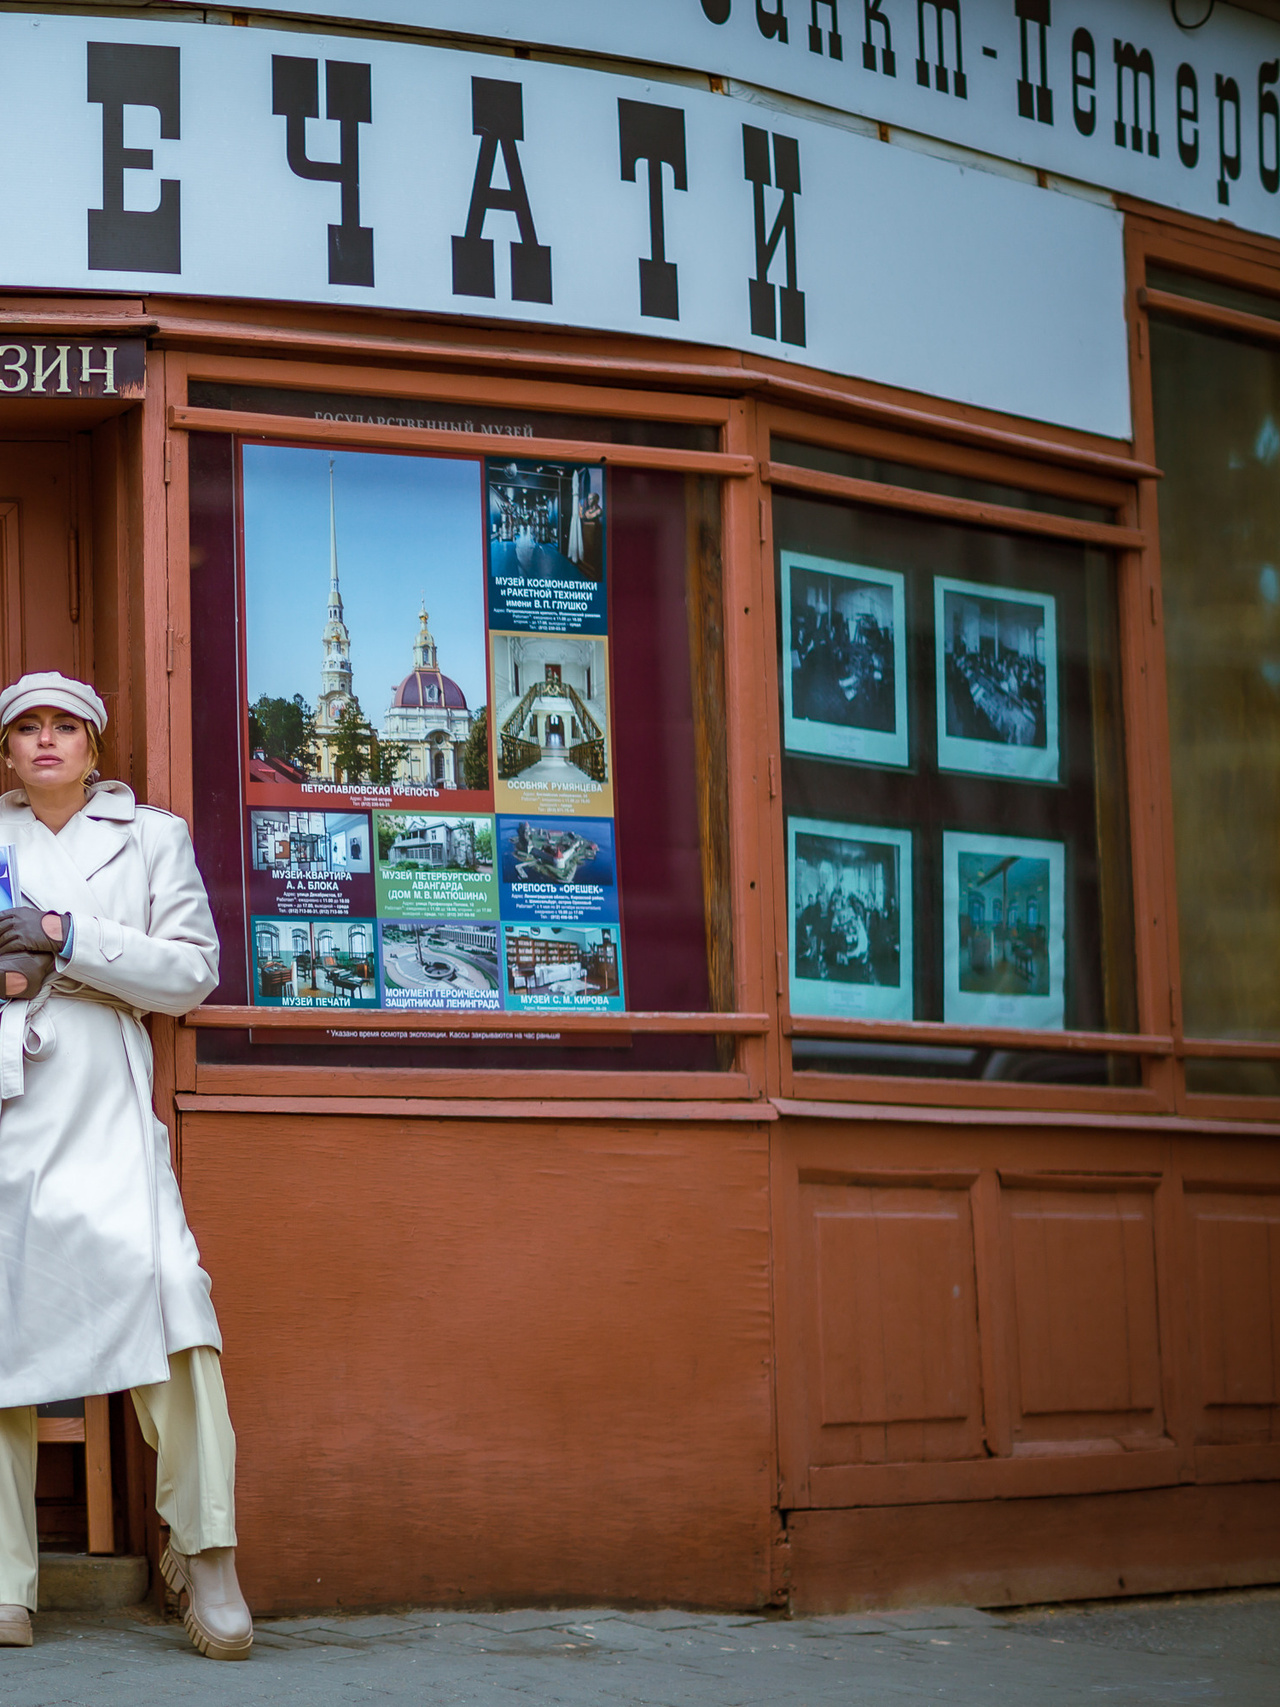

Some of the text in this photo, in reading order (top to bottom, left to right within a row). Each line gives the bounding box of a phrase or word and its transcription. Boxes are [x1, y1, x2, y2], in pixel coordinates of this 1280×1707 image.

[495, 576, 598, 591] МУЗЕЙ КОСМОНАВТИКИ
[507, 588, 551, 599] РАКЕТНОЙ
[554, 590, 593, 601] ТЕХНИКИ
[552, 601, 587, 611] ГЛУШКО
[301, 783, 439, 797] ПЕТРОПАВЛОВСКАЯ КРЕПОСТЬ
[507, 780, 603, 793] ОСОБНЯК РУМЯНЦЕВА
[272, 868, 352, 881] МУЗЕЙ-КВАРТИРА
[382, 870, 491, 882] МУЗЕЙ ПЕТЕРБУРГСКОГО
[286, 881, 339, 891] А. А. БЛОКА
[412, 881, 463, 891] АВАНГАРДА
[511, 883, 603, 894] КРЕПОСТЬ «ОРЕШЕК»
[388, 890, 487, 903] (ДОМ М. В. МАТЮШИНА)
[385, 988, 499, 999] МОНУМЕНТ ГЕРОИЧЕСКИМ
[520, 994, 609, 1005] МУЗЕЙ С. М. КИРОВА
[282, 995, 351, 1007] МУЗЕЙ ПЕЧАТИ
[385, 998, 500, 1009] ЗАЩИТНИКАМ ЛЕНИНГРАДА
